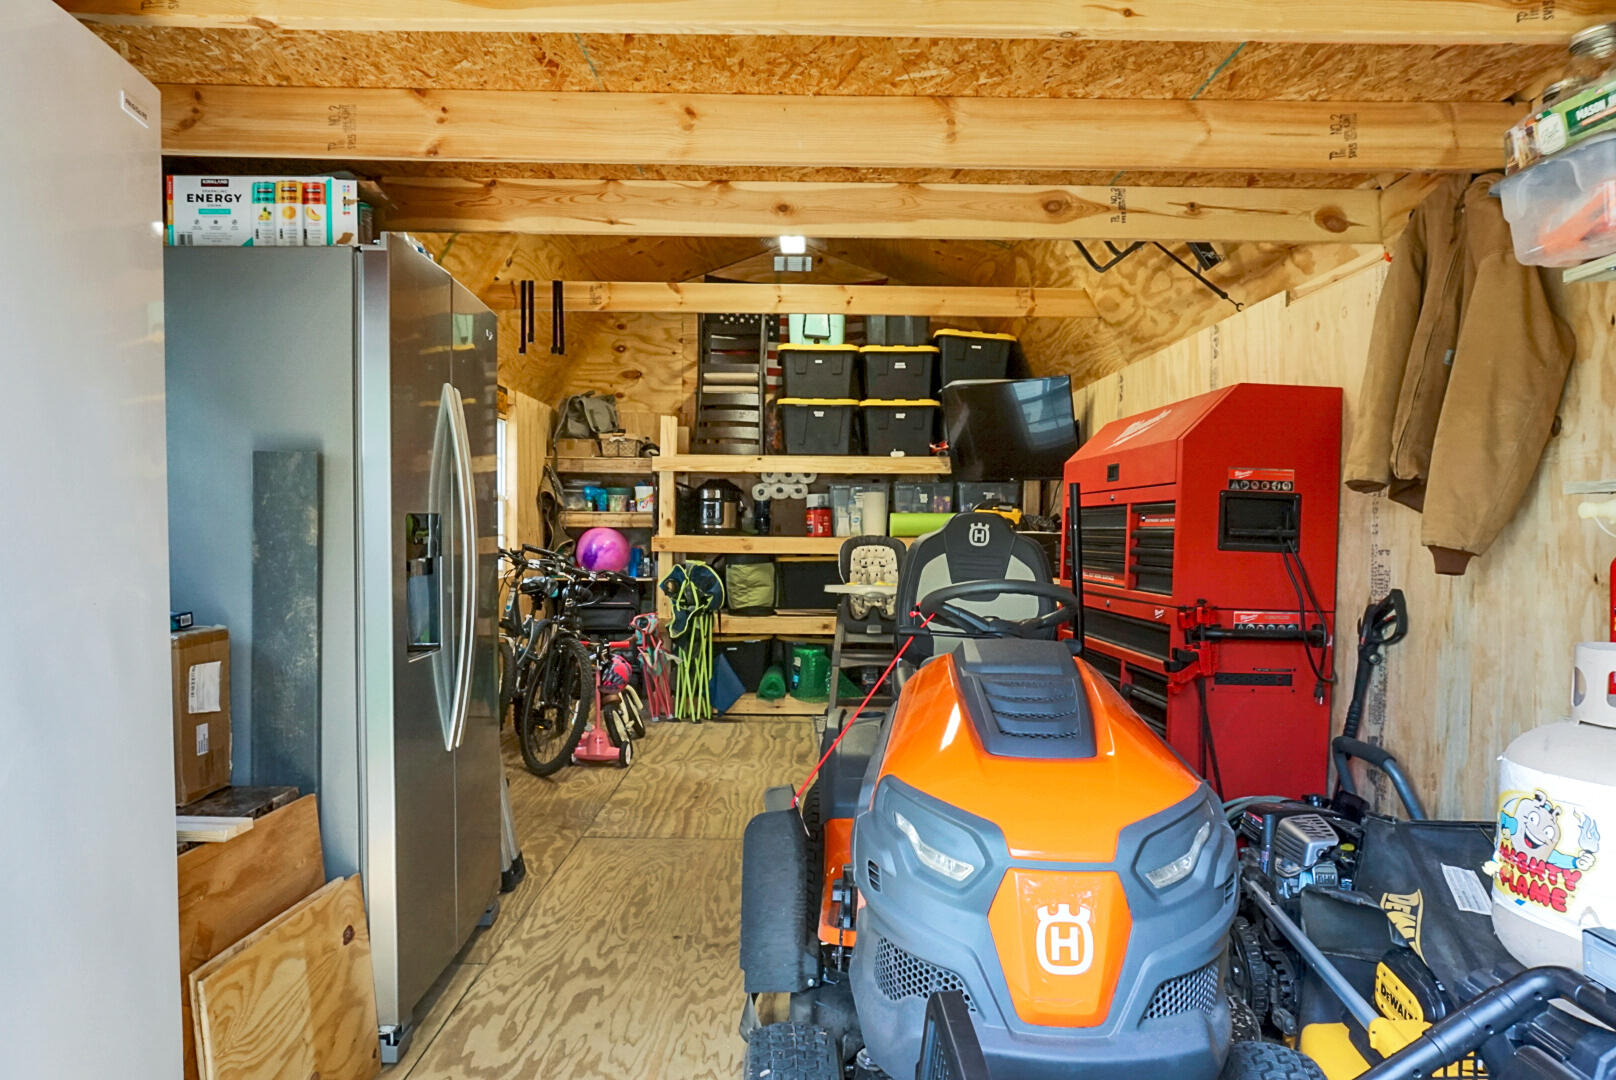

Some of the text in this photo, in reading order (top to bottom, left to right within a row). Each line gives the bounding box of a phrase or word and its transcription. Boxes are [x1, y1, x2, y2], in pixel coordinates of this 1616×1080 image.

[186, 193, 242, 203] ENERGY
[1499, 841, 1582, 891] MIGHTY
[1499, 864, 1567, 913] FLAME
